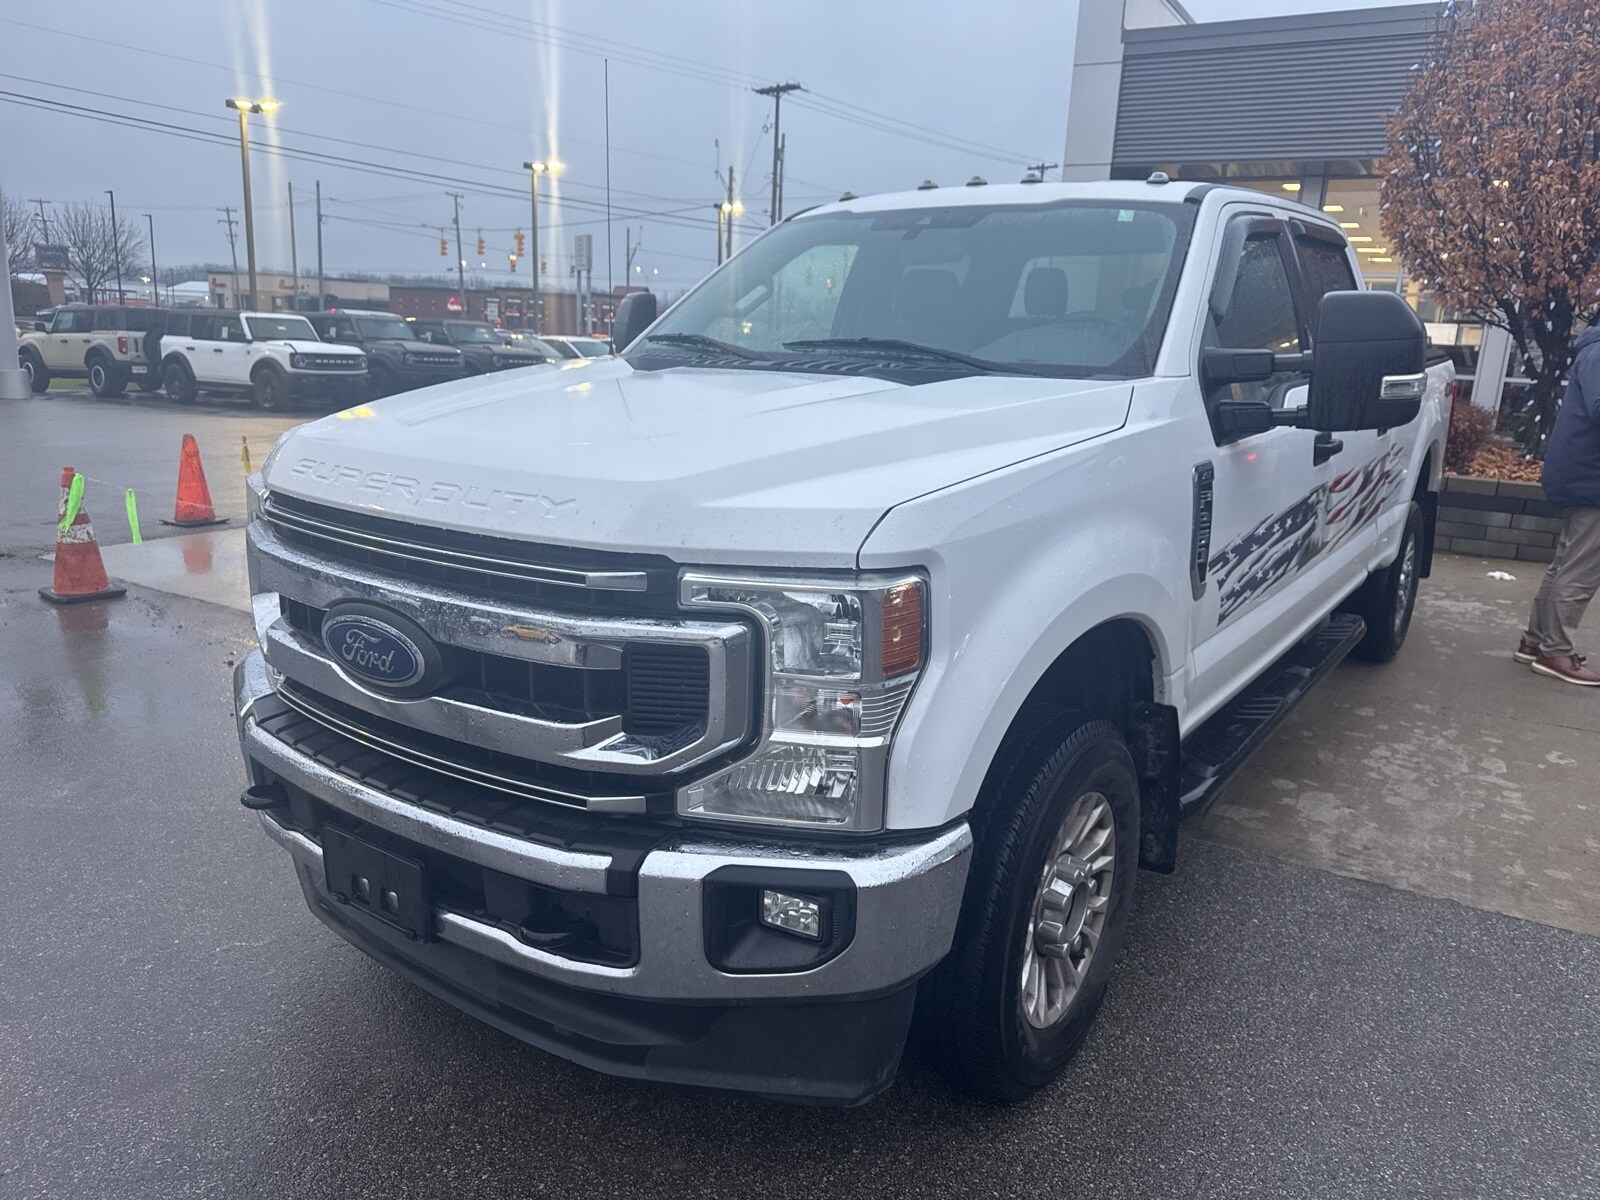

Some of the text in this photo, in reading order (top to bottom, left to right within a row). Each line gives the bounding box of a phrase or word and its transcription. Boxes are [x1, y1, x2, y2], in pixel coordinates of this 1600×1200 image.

[291, 458, 578, 519] SUPER DUTY
[341, 628, 395, 674] Ford
